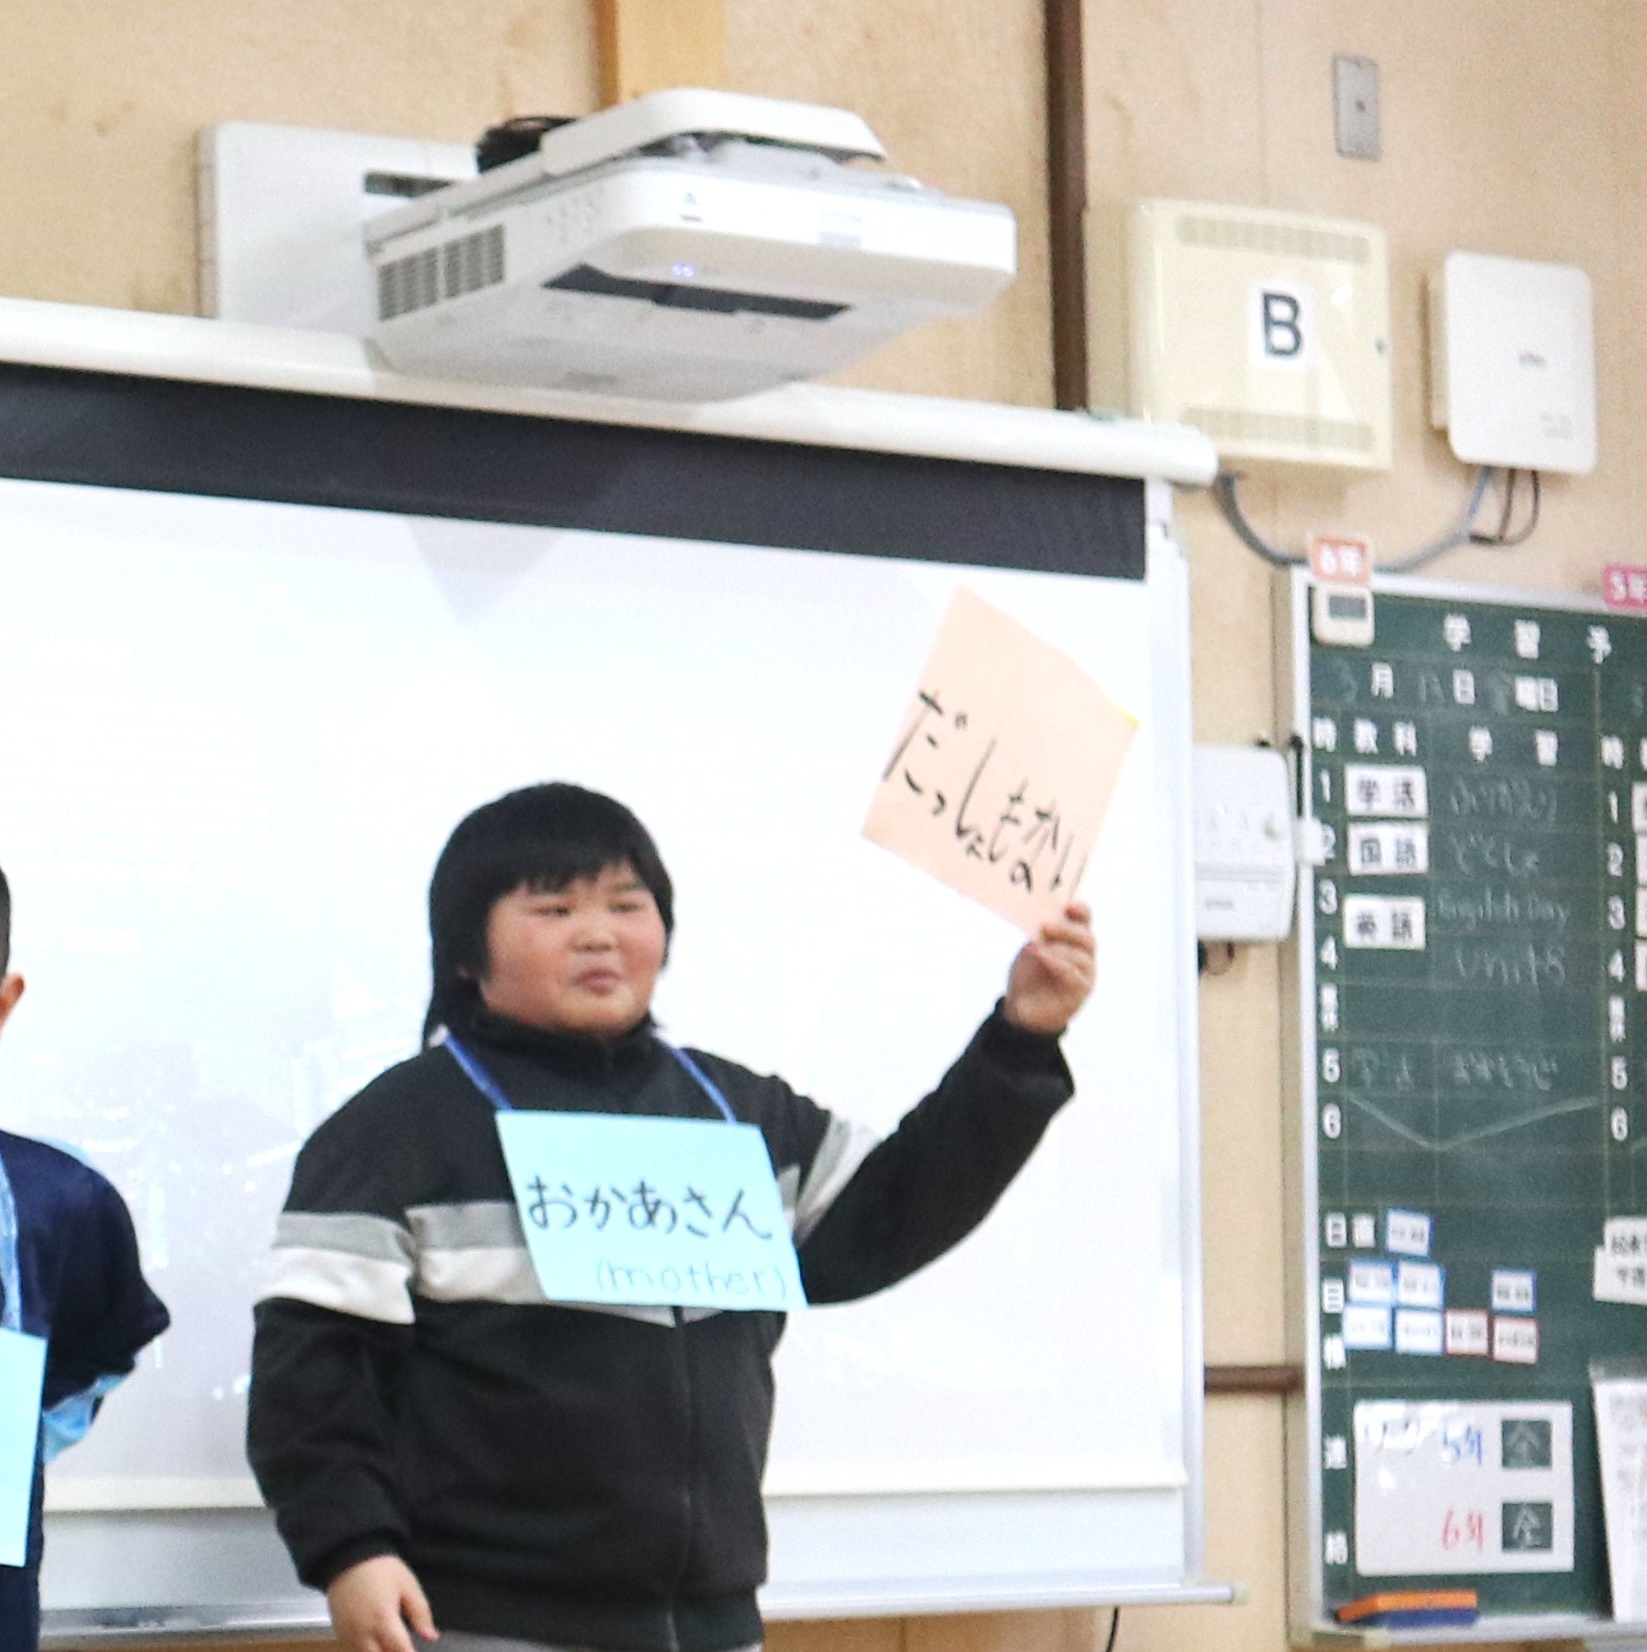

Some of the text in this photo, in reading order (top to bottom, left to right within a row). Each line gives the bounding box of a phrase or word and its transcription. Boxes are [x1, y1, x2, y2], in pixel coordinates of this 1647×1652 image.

[1261, 291, 1303, 357] B
[526, 1174, 774, 1241] おかあさん
